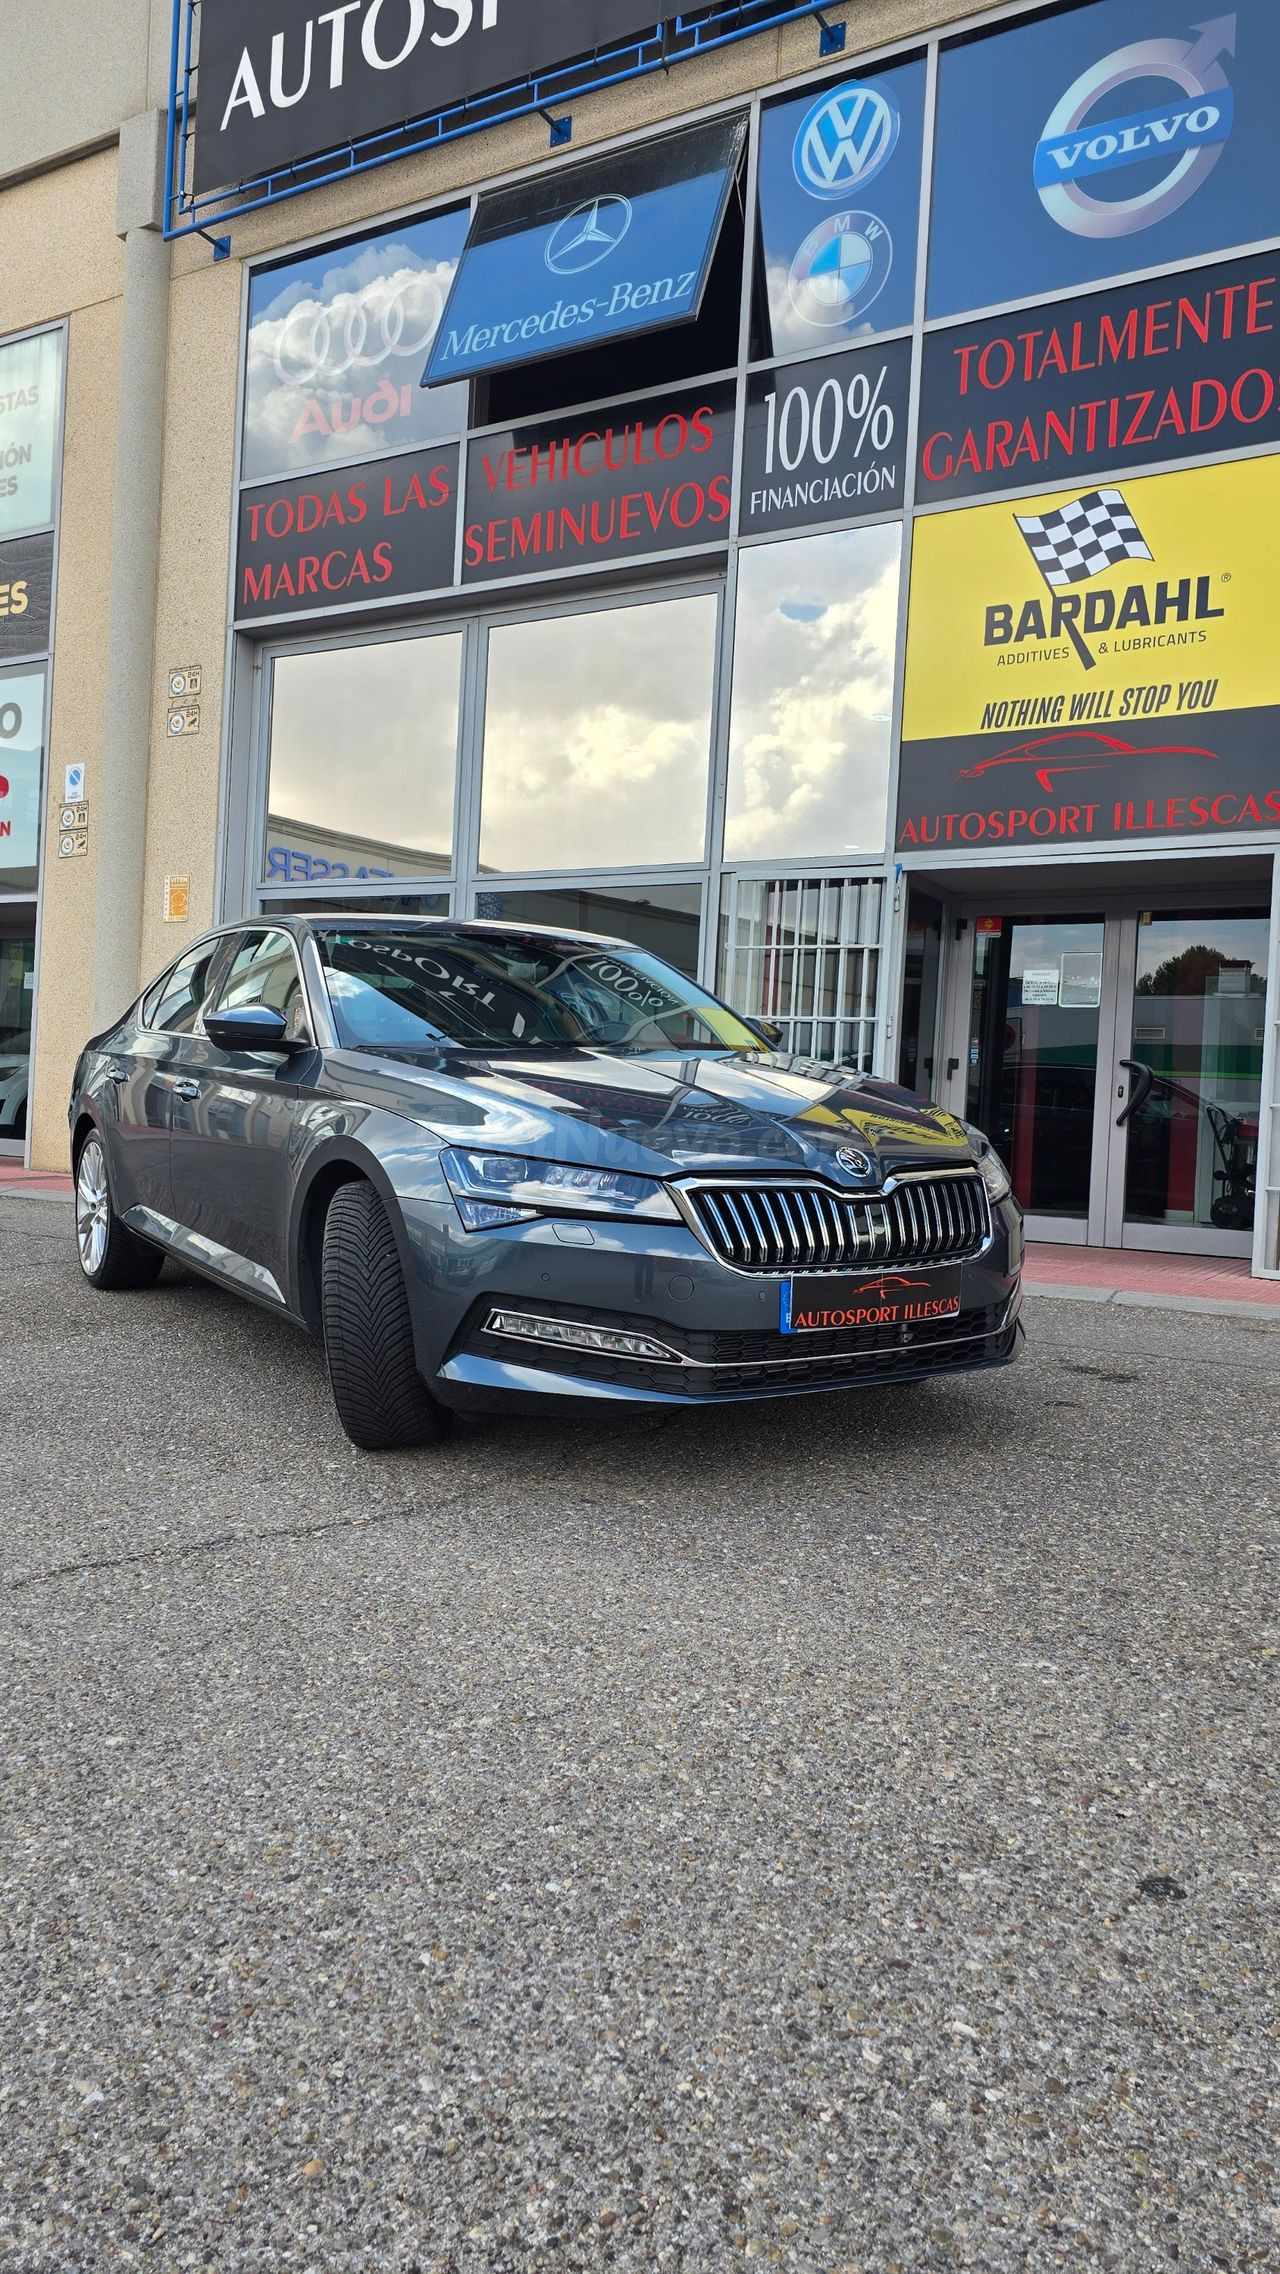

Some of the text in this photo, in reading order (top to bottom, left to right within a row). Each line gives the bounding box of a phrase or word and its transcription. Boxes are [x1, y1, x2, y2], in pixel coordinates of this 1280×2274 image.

[1046, 106, 1220, 170] VOLVO
[439, 271, 697, 361] Mercedes-Benz
[953, 277, 1276, 396] TOTALMENTE
[481, 406, 714, 494] VEHICULOS
[764, 366, 894, 474] 100%
[922, 368, 1280, 482] GARANTIZADO
[246, 464, 449, 542] TODAS LAS
[464, 475, 731, 567] SEMINUEVOS
[750, 460, 896, 515] FINANCIACIÓN
[243, 541, 393, 605] MARCAS
[984, 575, 1225, 671] BARDAHL
[997, 630, 1207, 666] ADDITIVES & LUBRICANTS
[980, 678, 1219, 729] NOTHING WILL STOP YOU
[900, 790, 1280, 844] AUTOSPORT ILLESCAS
[795, 1296, 960, 1328] AUTOSPORT ILLESCAS
